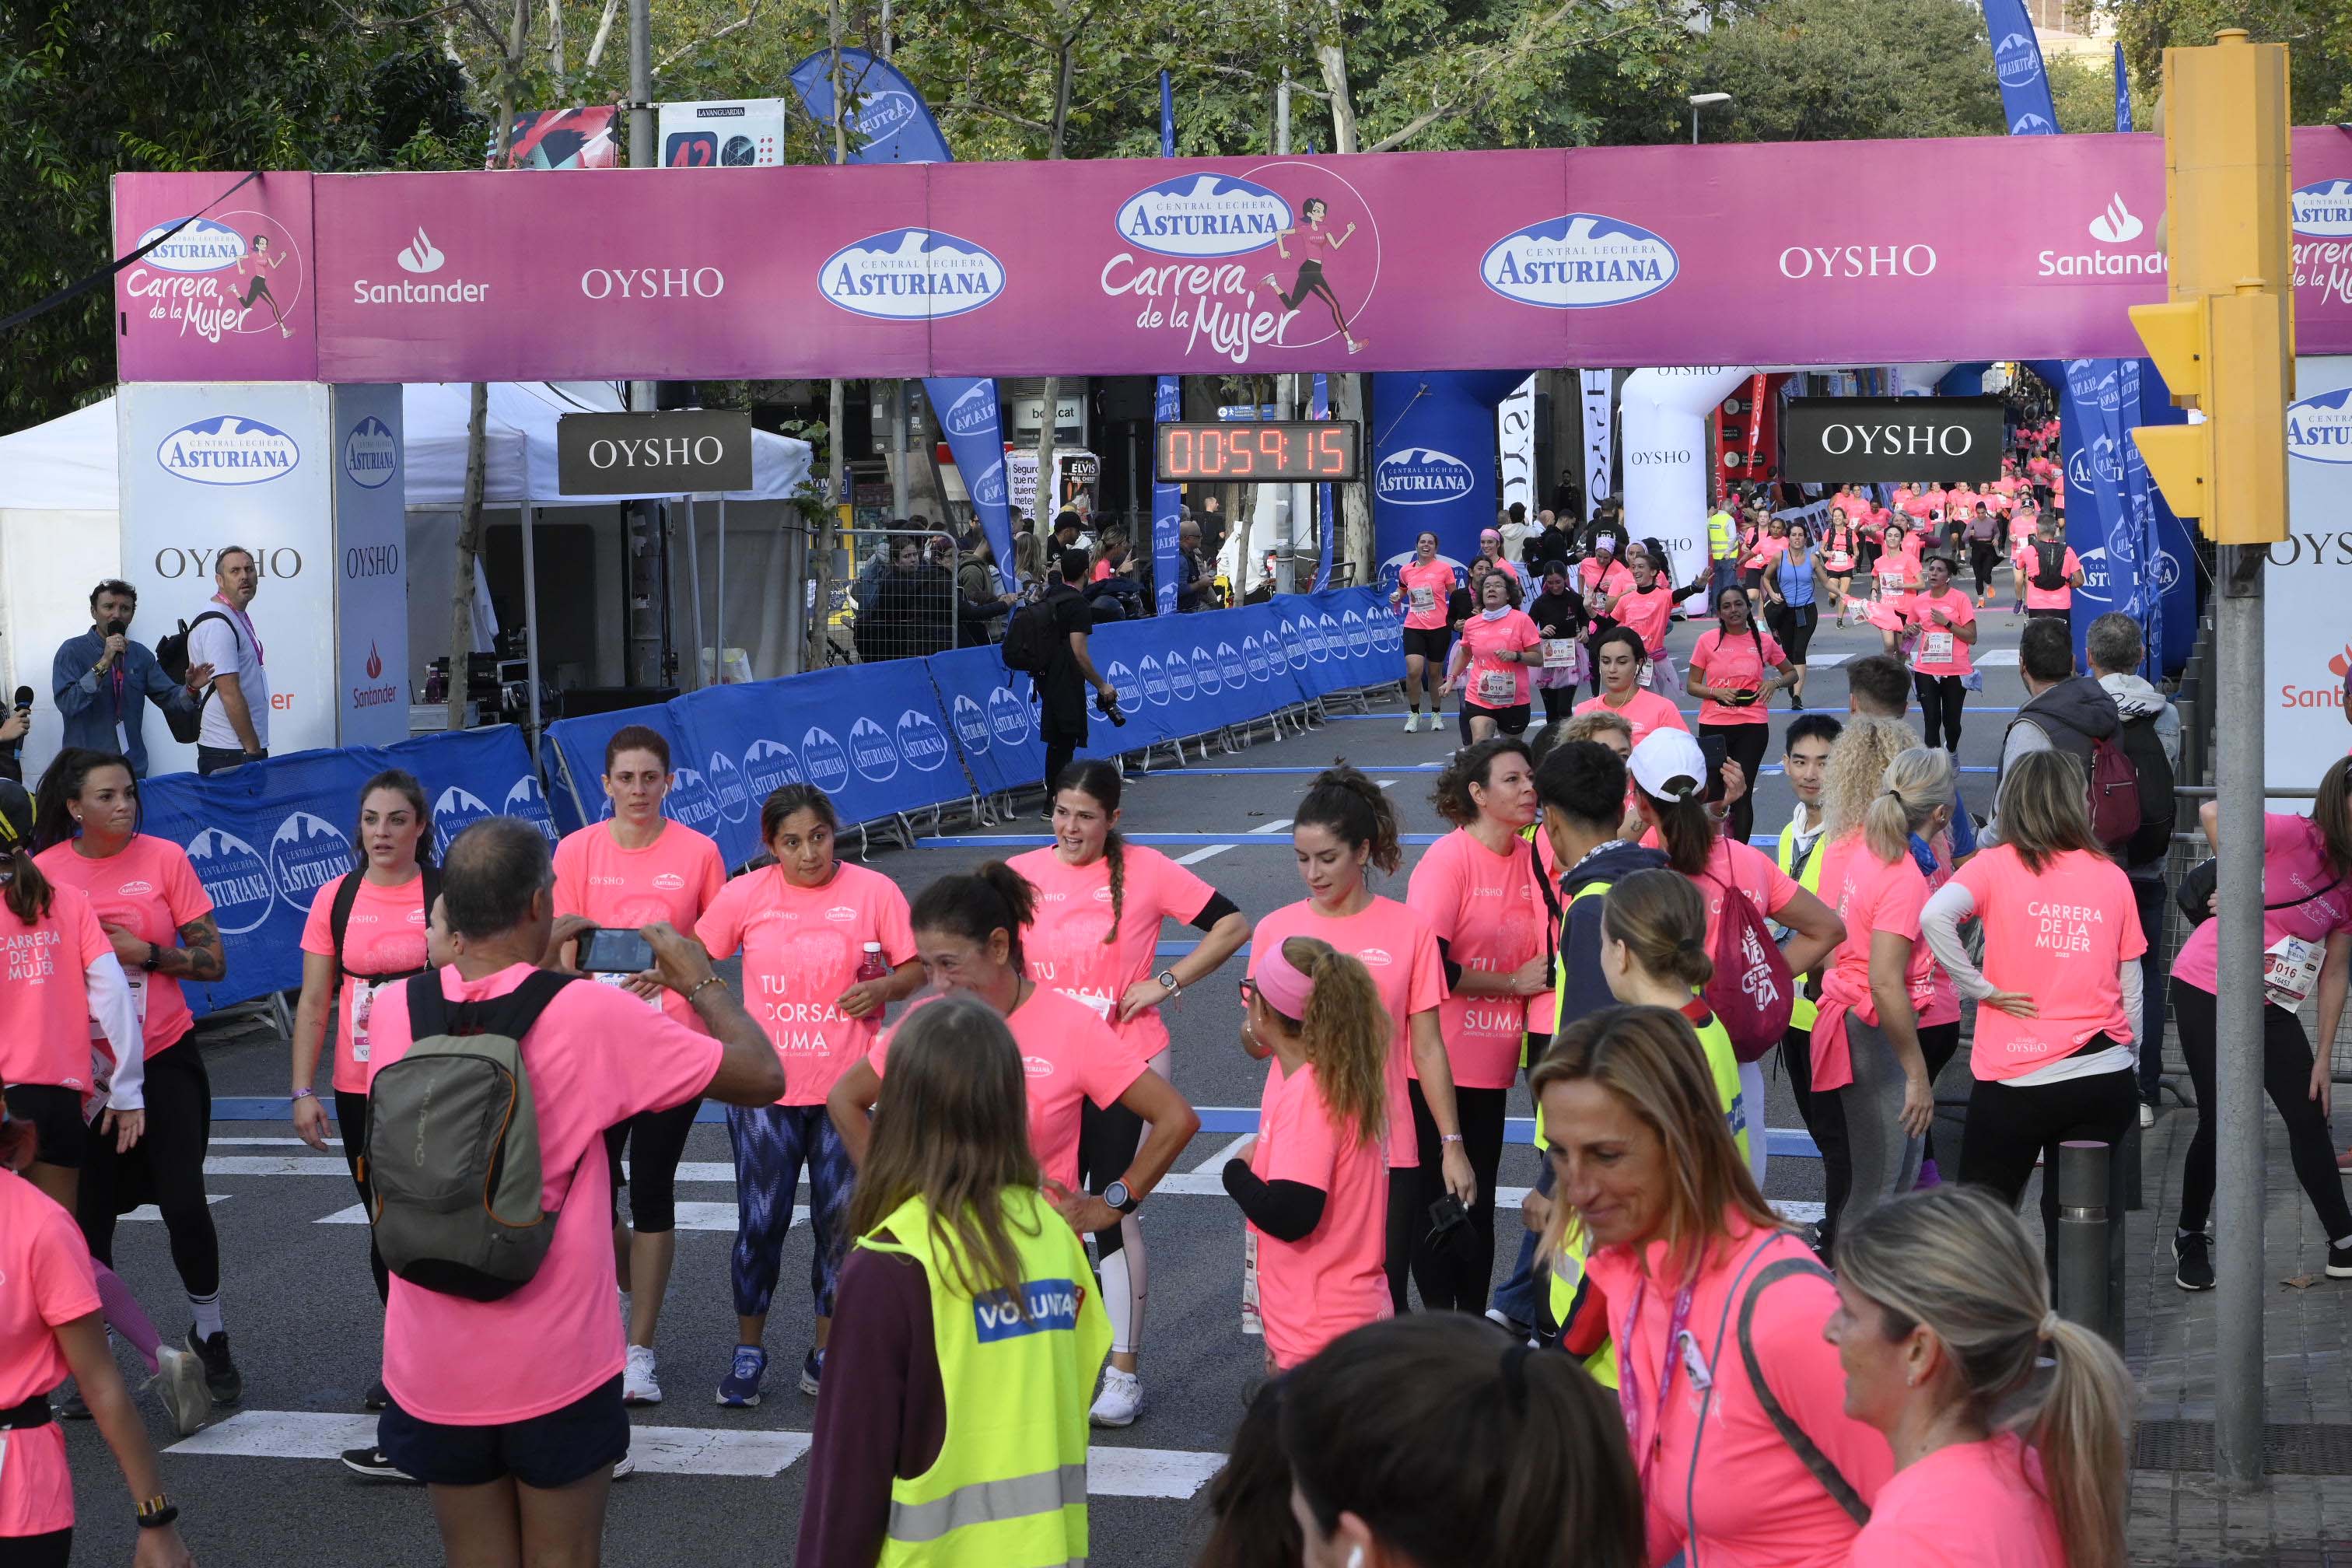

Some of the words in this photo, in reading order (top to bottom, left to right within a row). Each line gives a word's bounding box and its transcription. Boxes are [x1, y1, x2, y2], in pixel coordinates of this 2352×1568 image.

[705, 108, 744, 117] VANGUARDIA
[1156, 201, 1212, 211] CENTRAL
[1217, 201, 1274, 210] LECHERA
[1129, 205, 1279, 236] ASTURIANA
[1526, 246, 1587, 257] CENTRAL
[1593, 244, 1657, 255] LECHERA
[1779, 243, 1937, 279] OYSHO
[2293, 242, 2352, 264] arrer
[861, 260, 919, 269] CENTRAL
[923, 259, 985, 268] LECHERA
[1101, 253, 1246, 296] Carrera
[1496, 250, 1663, 286] ASTURIANA
[2039, 250, 2168, 276] Santand
[127, 268, 218, 298] Carrera
[582, 267, 724, 299] OYSHO
[832, 262, 992, 296] ASTURIANA
[2311, 265, 2325, 286] la
[354, 279, 490, 304] Santander
[149, 300, 166, 319] de
[170, 299, 182, 319] la
[180, 295, 254, 343] Mujer
[1136, 299, 1163, 328] de
[1170, 297, 1189, 328] la
[1185, 289, 1302, 364] Mujer
[1822, 424, 1972, 456] OYSHO
[2287, 417, 2352, 445] ASTU
[169, 441, 289, 467] ASTURIANA
[349, 443, 394, 471] ASTURIANA
[589, 436, 723, 468] OYSHO
[1170, 430, 1343, 474] 00:59:15
[1632, 450, 1691, 466] OYSHO
[1072, 464, 1095, 474] ELVIS
[1014, 477, 1027, 486] que
[1378, 471, 1467, 492] ASTURIANA
[2266, 532, 2352, 566] OYS
[155, 548, 302, 579] OYHO
[346, 544, 398, 579] OYSHO
[353, 685, 397, 709] Santander
[2281, 684, 2344, 709] Sant
[806, 753, 846, 779] ASTURIANA
[854, 744, 897, 768] ASTURIANA
[286, 848, 314, 860] CENTRAL
[315, 841, 344, 855] LECHERA
[198, 865, 227, 878] CENTRAL
[278, 855, 352, 894] ASTURIANA
[590, 877, 625, 885] OYSHO
[202, 873, 271, 908] STURIANA
[2290, 873, 2312, 896] Sports
[2028, 901, 2103, 923] CARRERA
[2040, 919, 2061, 934] DE
[2068, 920, 2089, 936] LA
[2035, 933, 2091, 953] MUJER
[10, 950, 30, 965] DE
[34, 947, 51, 961] LA
[9, 961, 54, 982] MUJER
[1033, 961, 1055, 980] TU
[2274, 976, 2291, 987] 16453
[2276, 963, 2298, 978] 016
[761, 975, 786, 995] TU
[765, 1003, 849, 1023] DORSAL
[1465, 1010, 1523, 1031] SUMA
[775, 1031, 828, 1050] UMA
[2007, 1043, 2047, 1052] OYSHO
